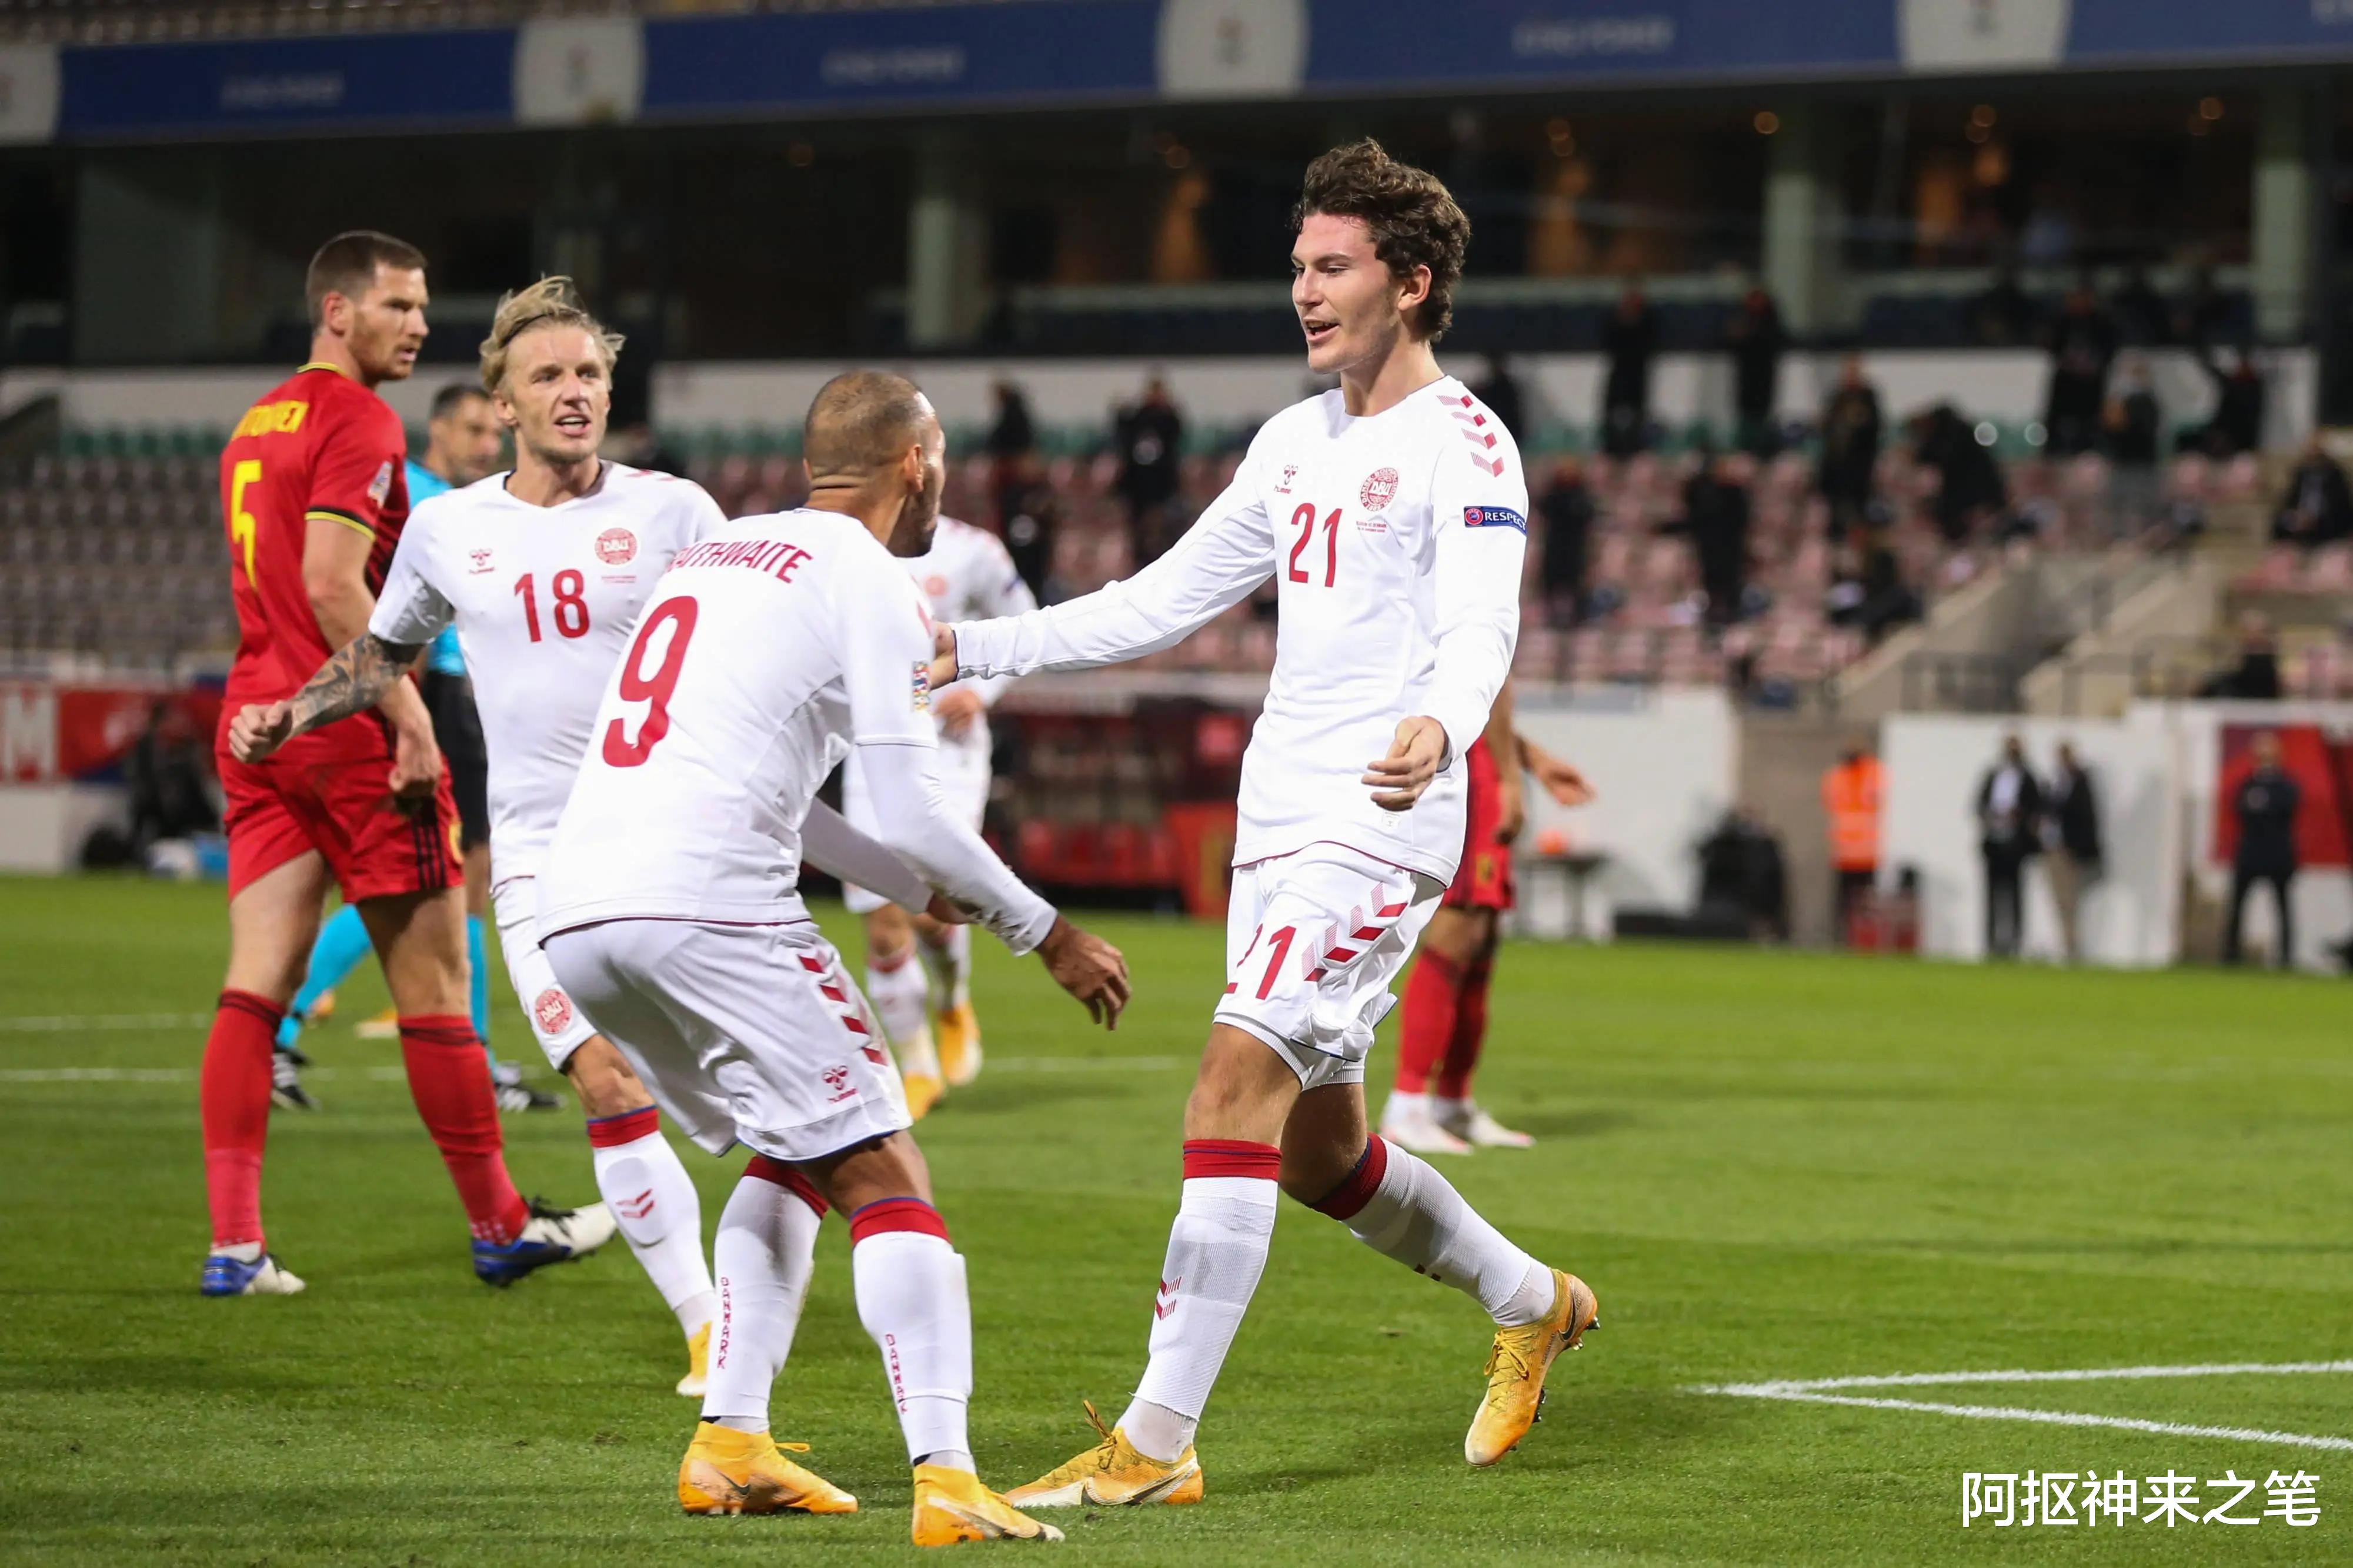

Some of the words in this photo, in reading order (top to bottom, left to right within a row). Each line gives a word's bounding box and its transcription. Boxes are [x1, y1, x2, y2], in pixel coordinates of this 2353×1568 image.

[230, 459, 262, 591] 5
[667, 540, 813, 584] AITHWAITE
[1289, 502, 1343, 588] 21
[1484, 511, 1526, 531] RESPECT
[513, 569, 590, 643] 18
[602, 595, 699, 768] 9
[716, 1276, 732, 1370] DANMARK
